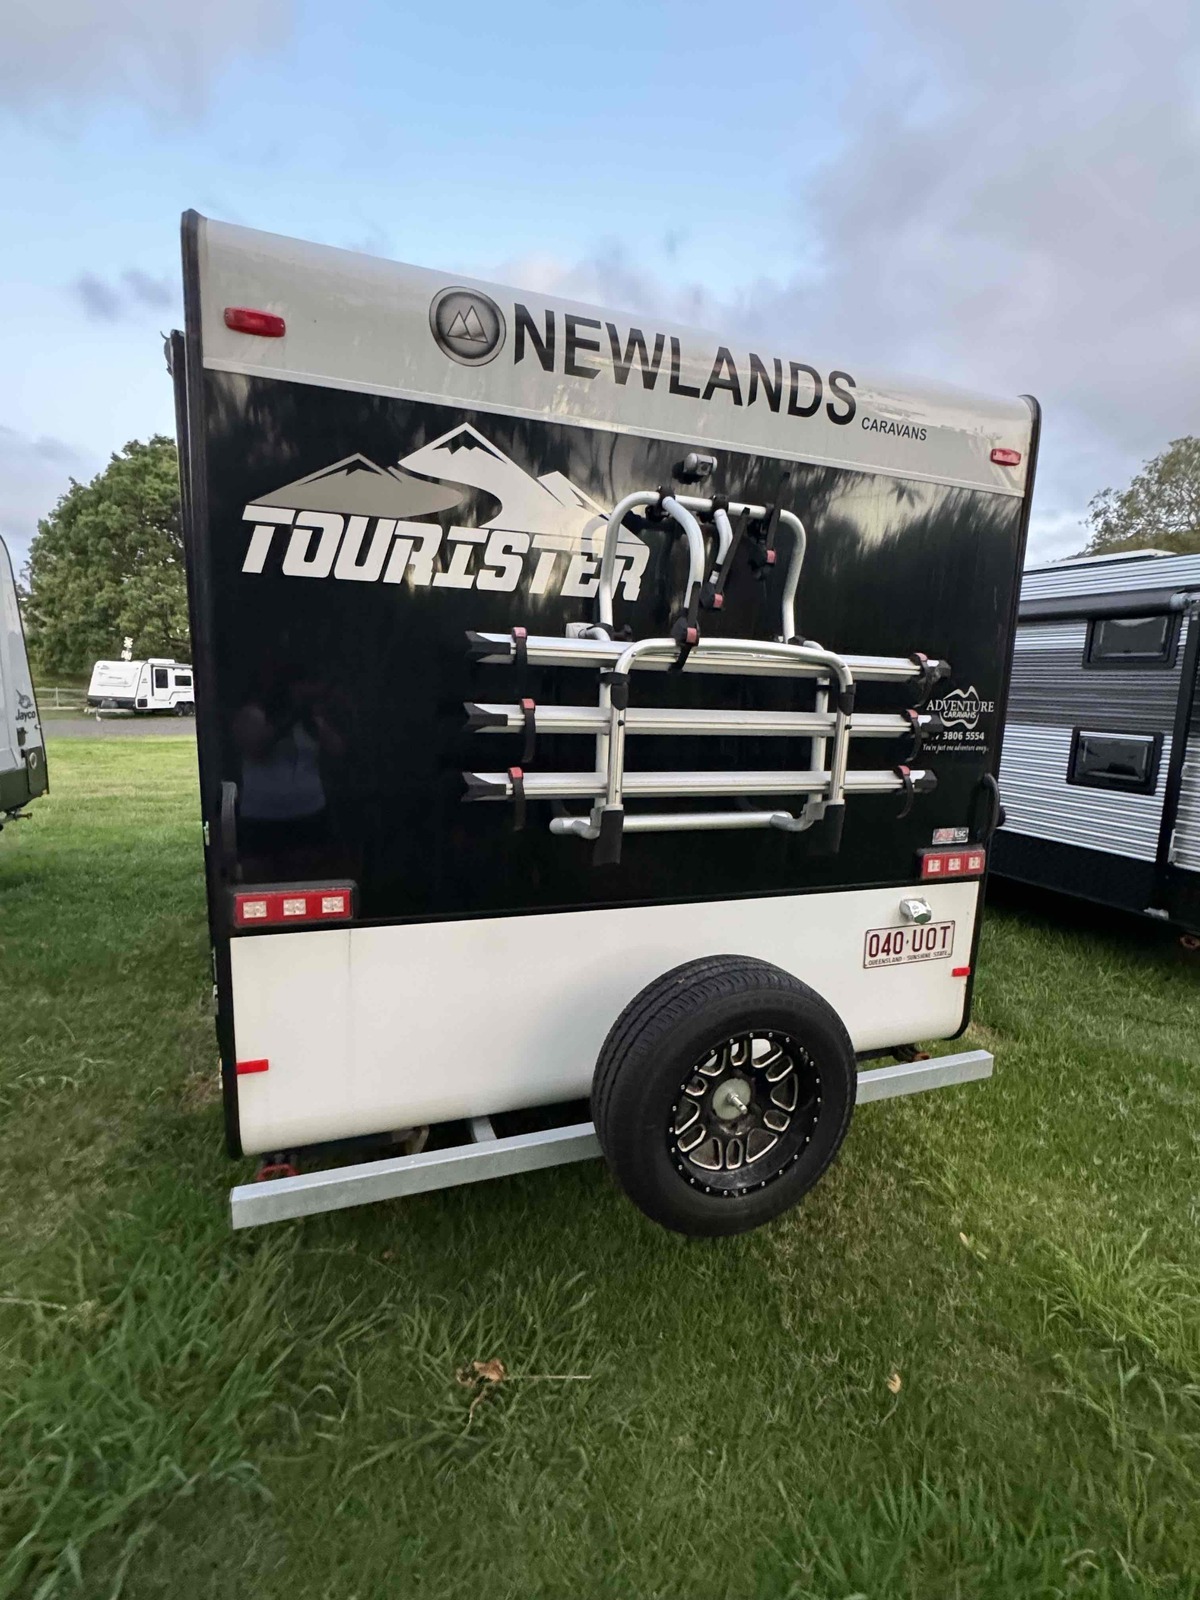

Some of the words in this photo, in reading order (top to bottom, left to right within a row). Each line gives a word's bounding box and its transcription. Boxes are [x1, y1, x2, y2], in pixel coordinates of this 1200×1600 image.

[513, 302, 857, 426] NEWLANDS
[861, 416, 927, 441] CARAVANS
[241, 504, 650, 601] TOURISTER
[926, 699, 995, 713] ADVENTURE
[15, 709, 36, 722] Jayco
[943, 711, 976, 719] CARAVANS
[942, 731, 963, 740] 3806
[965, 731, 985, 740] 5554
[868, 956, 903, 966] QUEENSLAND
[906, 952, 931, 962] SUNSHINE
[933, 950, 948, 958] STATE
